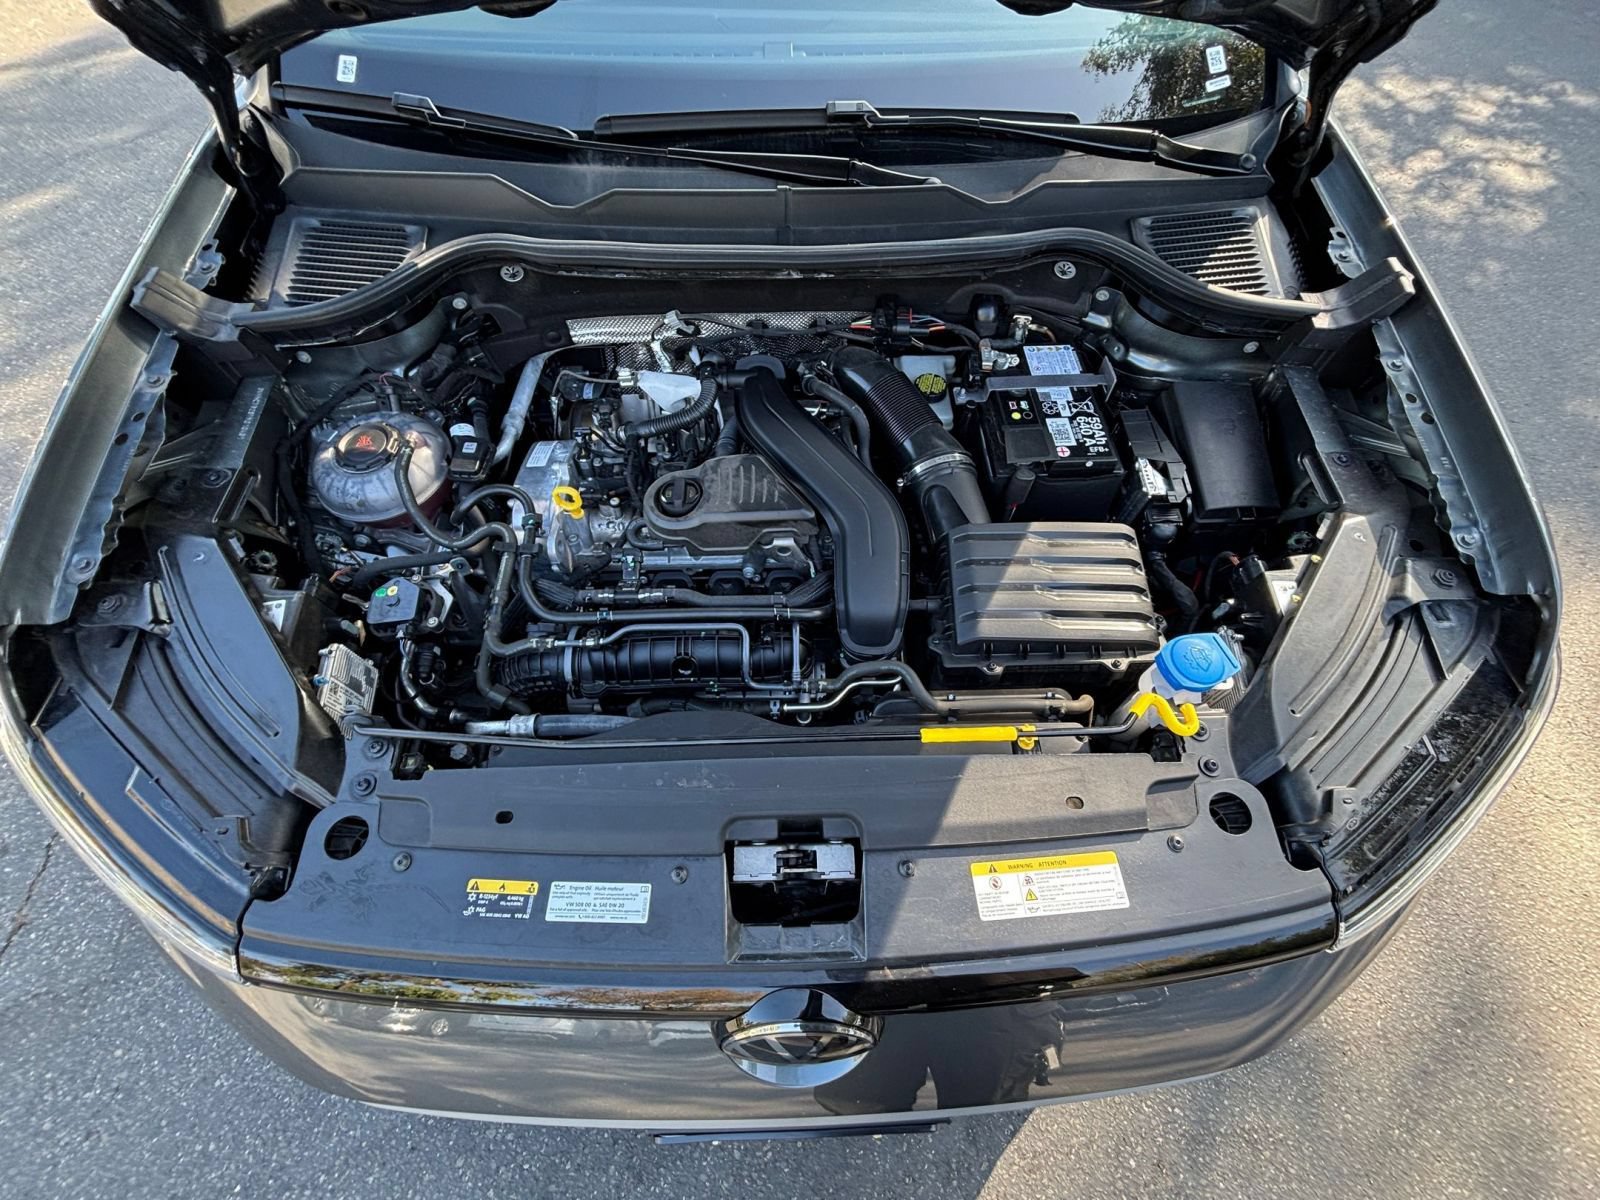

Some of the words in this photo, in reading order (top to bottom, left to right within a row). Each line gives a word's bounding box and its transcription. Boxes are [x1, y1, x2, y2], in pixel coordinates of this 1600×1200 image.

[1076, 416, 1093, 436] 640
[1088, 416, 1107, 445] 59Ah
[1083, 437, 1097, 447] A
[1007, 862, 1034, 870] WARNING
[1038, 859, 1067, 868] ATTENTION
